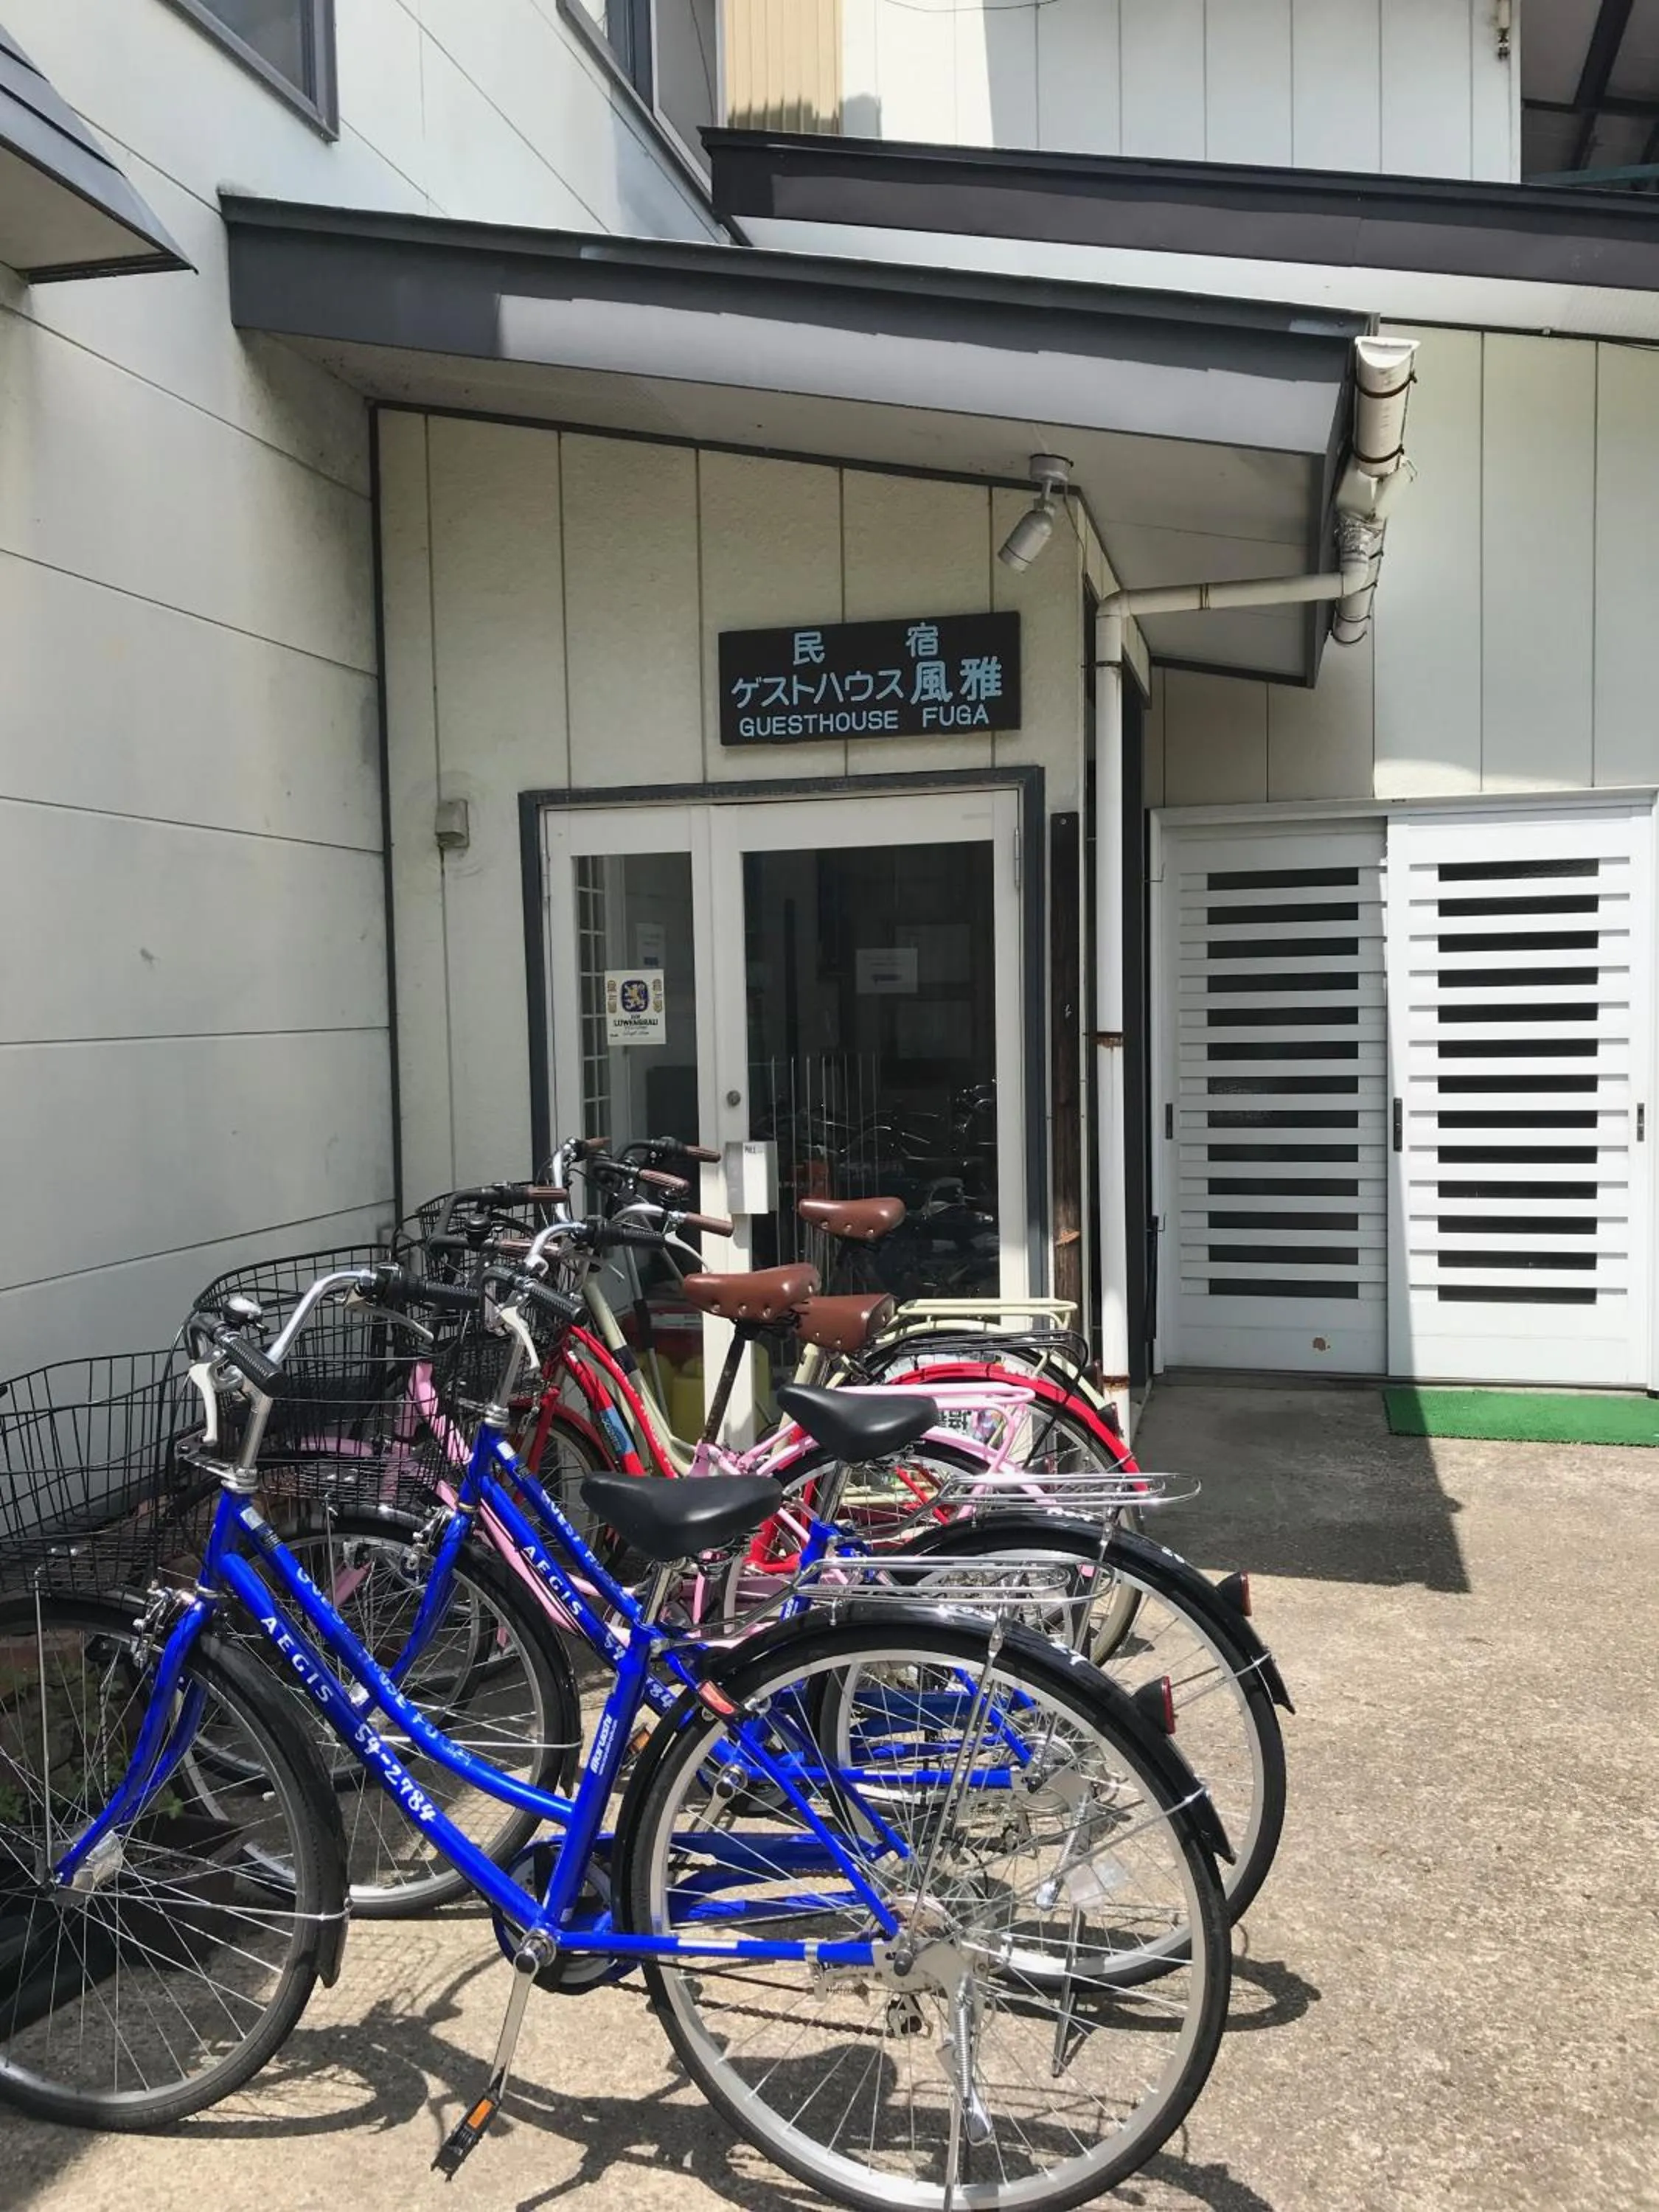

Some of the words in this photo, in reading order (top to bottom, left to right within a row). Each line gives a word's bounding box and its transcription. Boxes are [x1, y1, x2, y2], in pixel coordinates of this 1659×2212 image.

[739, 709, 900, 737] GUESTHOUSE
[922, 703, 990, 728] FUGA
[523, 1546, 583, 1615] AEGIS
[260, 1616, 335, 1703] AEGIS
